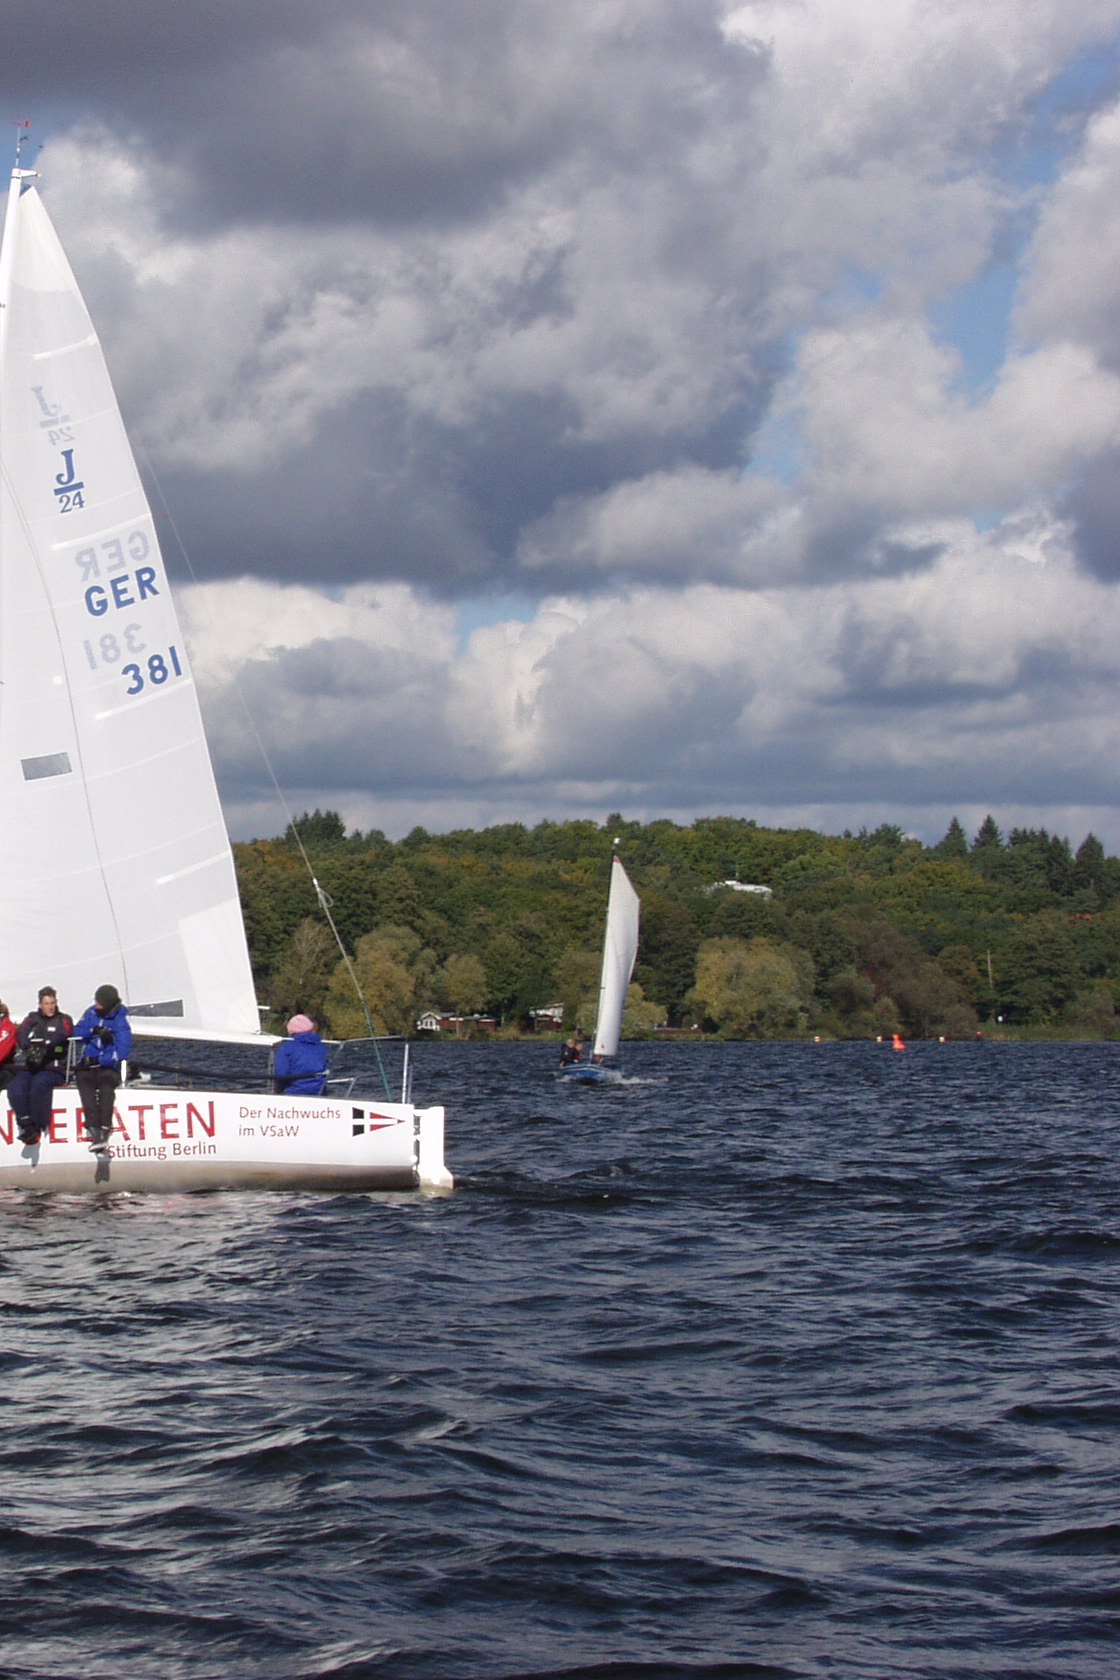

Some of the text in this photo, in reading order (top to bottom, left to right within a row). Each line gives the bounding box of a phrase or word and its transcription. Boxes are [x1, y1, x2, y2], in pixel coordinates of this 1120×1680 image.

[56, 449, 75, 485] J
[58, 491, 85, 513] 24
[84, 566, 159, 616] GER
[121, 646, 182, 695] 381
[239, 1107, 341, 1119] Der Nachwuchs
[239, 1125, 299, 1137] im VSaW
[108, 1141, 216, 1160] Stiftung Berlin
